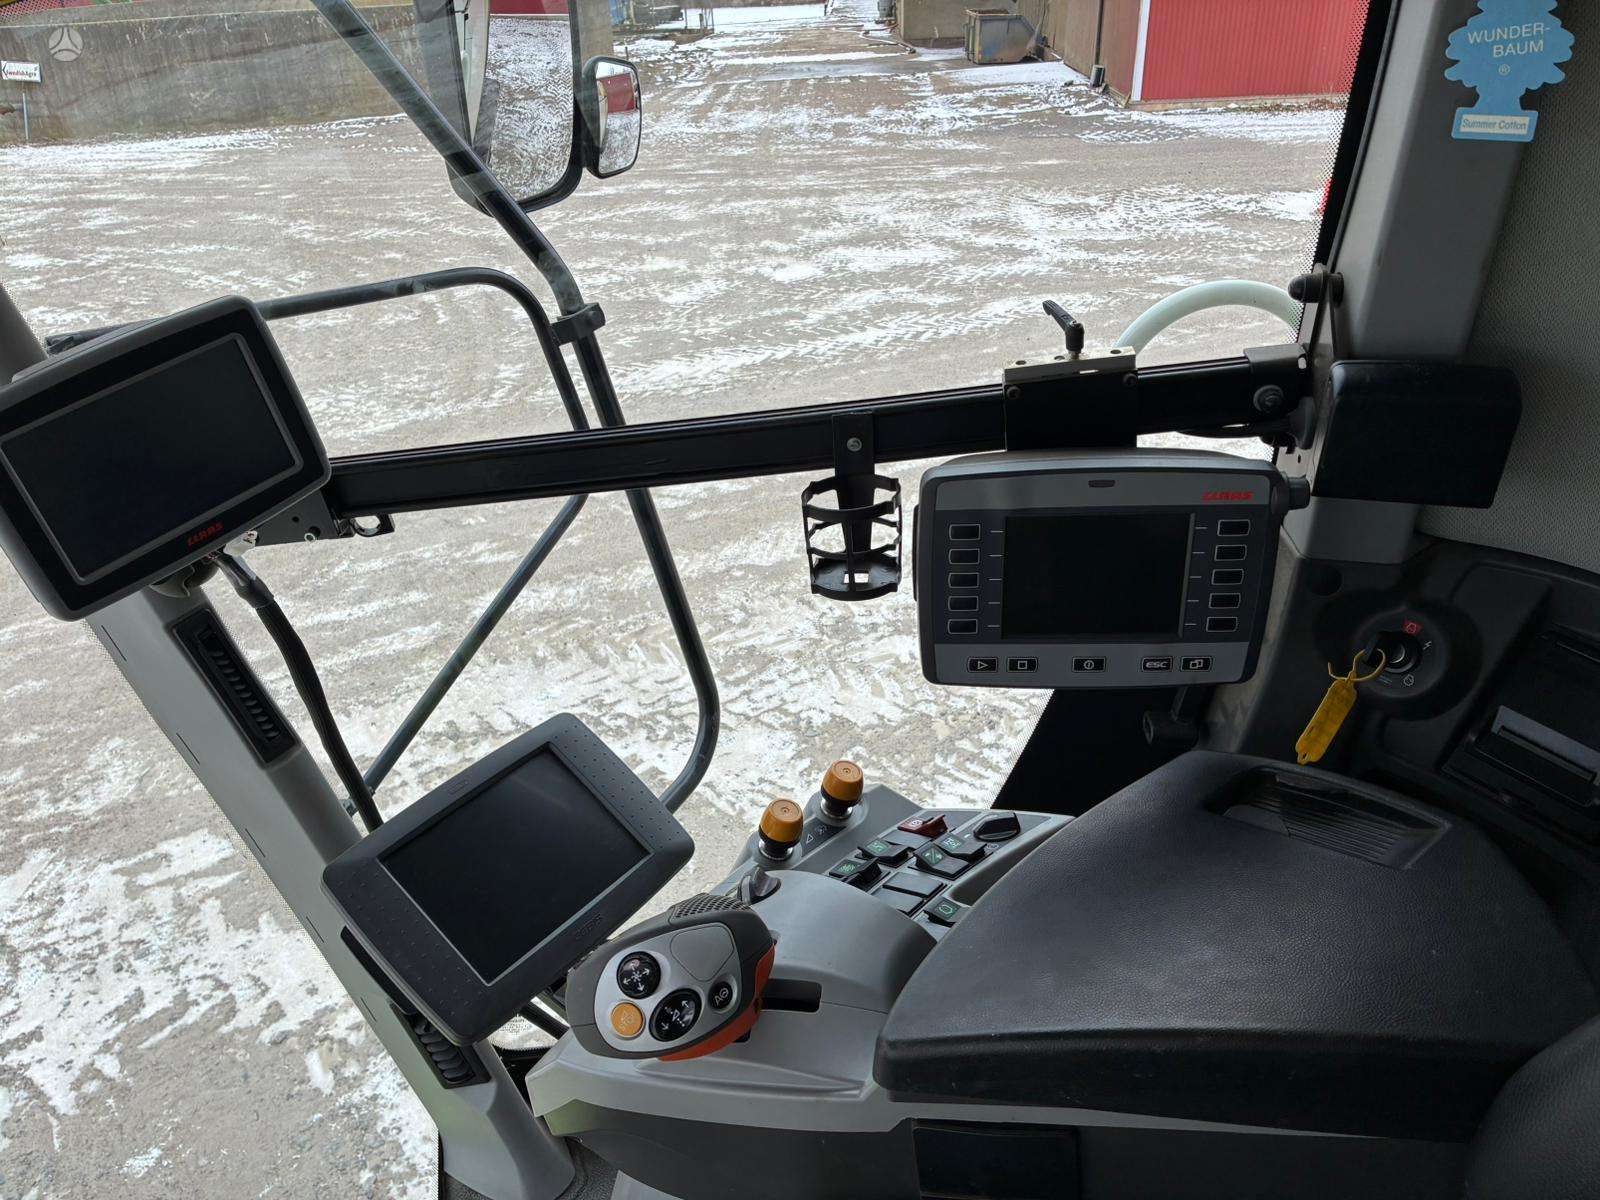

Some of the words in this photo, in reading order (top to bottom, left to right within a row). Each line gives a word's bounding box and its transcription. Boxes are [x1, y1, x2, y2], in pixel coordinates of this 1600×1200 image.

[1467, 22, 1551, 44] WUNDER-
[1493, 39, 1544, 58] BAUM
[1462, 118, 1497, 129] Summer
[1498, 119, 1527, 130] Cotton
[187, 521, 224, 546] CLAAS
